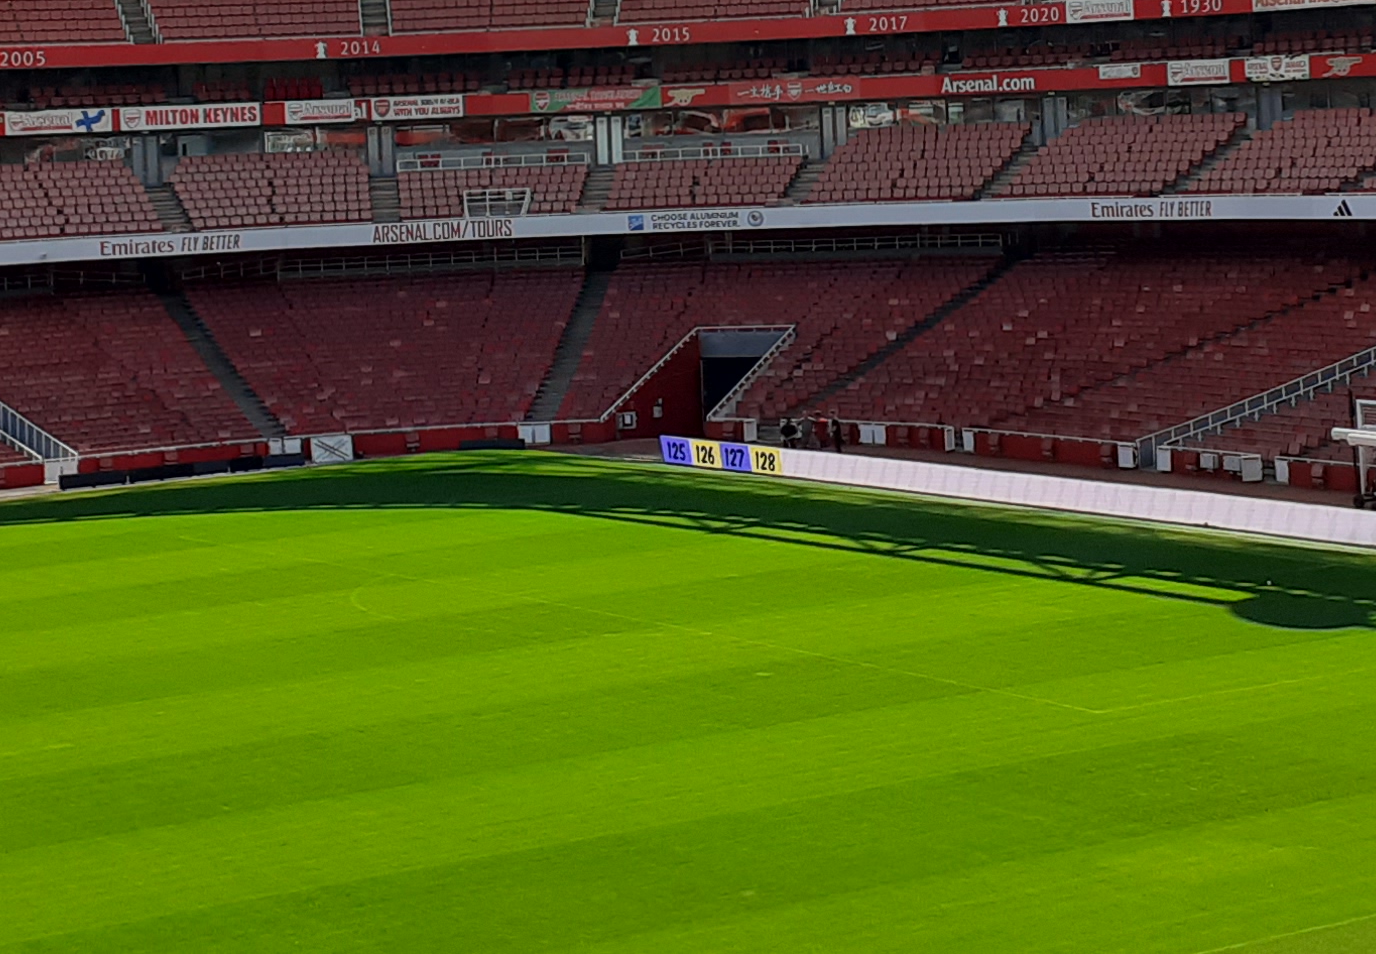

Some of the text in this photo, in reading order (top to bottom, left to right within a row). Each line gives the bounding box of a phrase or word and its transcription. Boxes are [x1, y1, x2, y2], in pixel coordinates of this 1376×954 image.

[869, 16, 908, 31] 2017
[1021, 7, 1059, 22] 2020
[652, 28, 690, 42] 2015
[341, 41, 380, 56] 2014
[0, 51, 46, 67] 2005
[941, 75, 1035, 94] Arsenal.com
[145, 106, 257, 126] MILTON KEYNES
[651, 213, 688, 221] CHOOSE
[1091, 201, 1212, 218] Emirates FLY BETTER
[373, 220, 512, 243] ARSENAL.COM/TOURS
[100, 234, 240, 256] Emirates FLY BETTER
[667, 441, 685, 461] 125
[695, 444, 714, 464] 126
[725, 447, 744, 468] 127
[755, 450, 775, 471] 128
